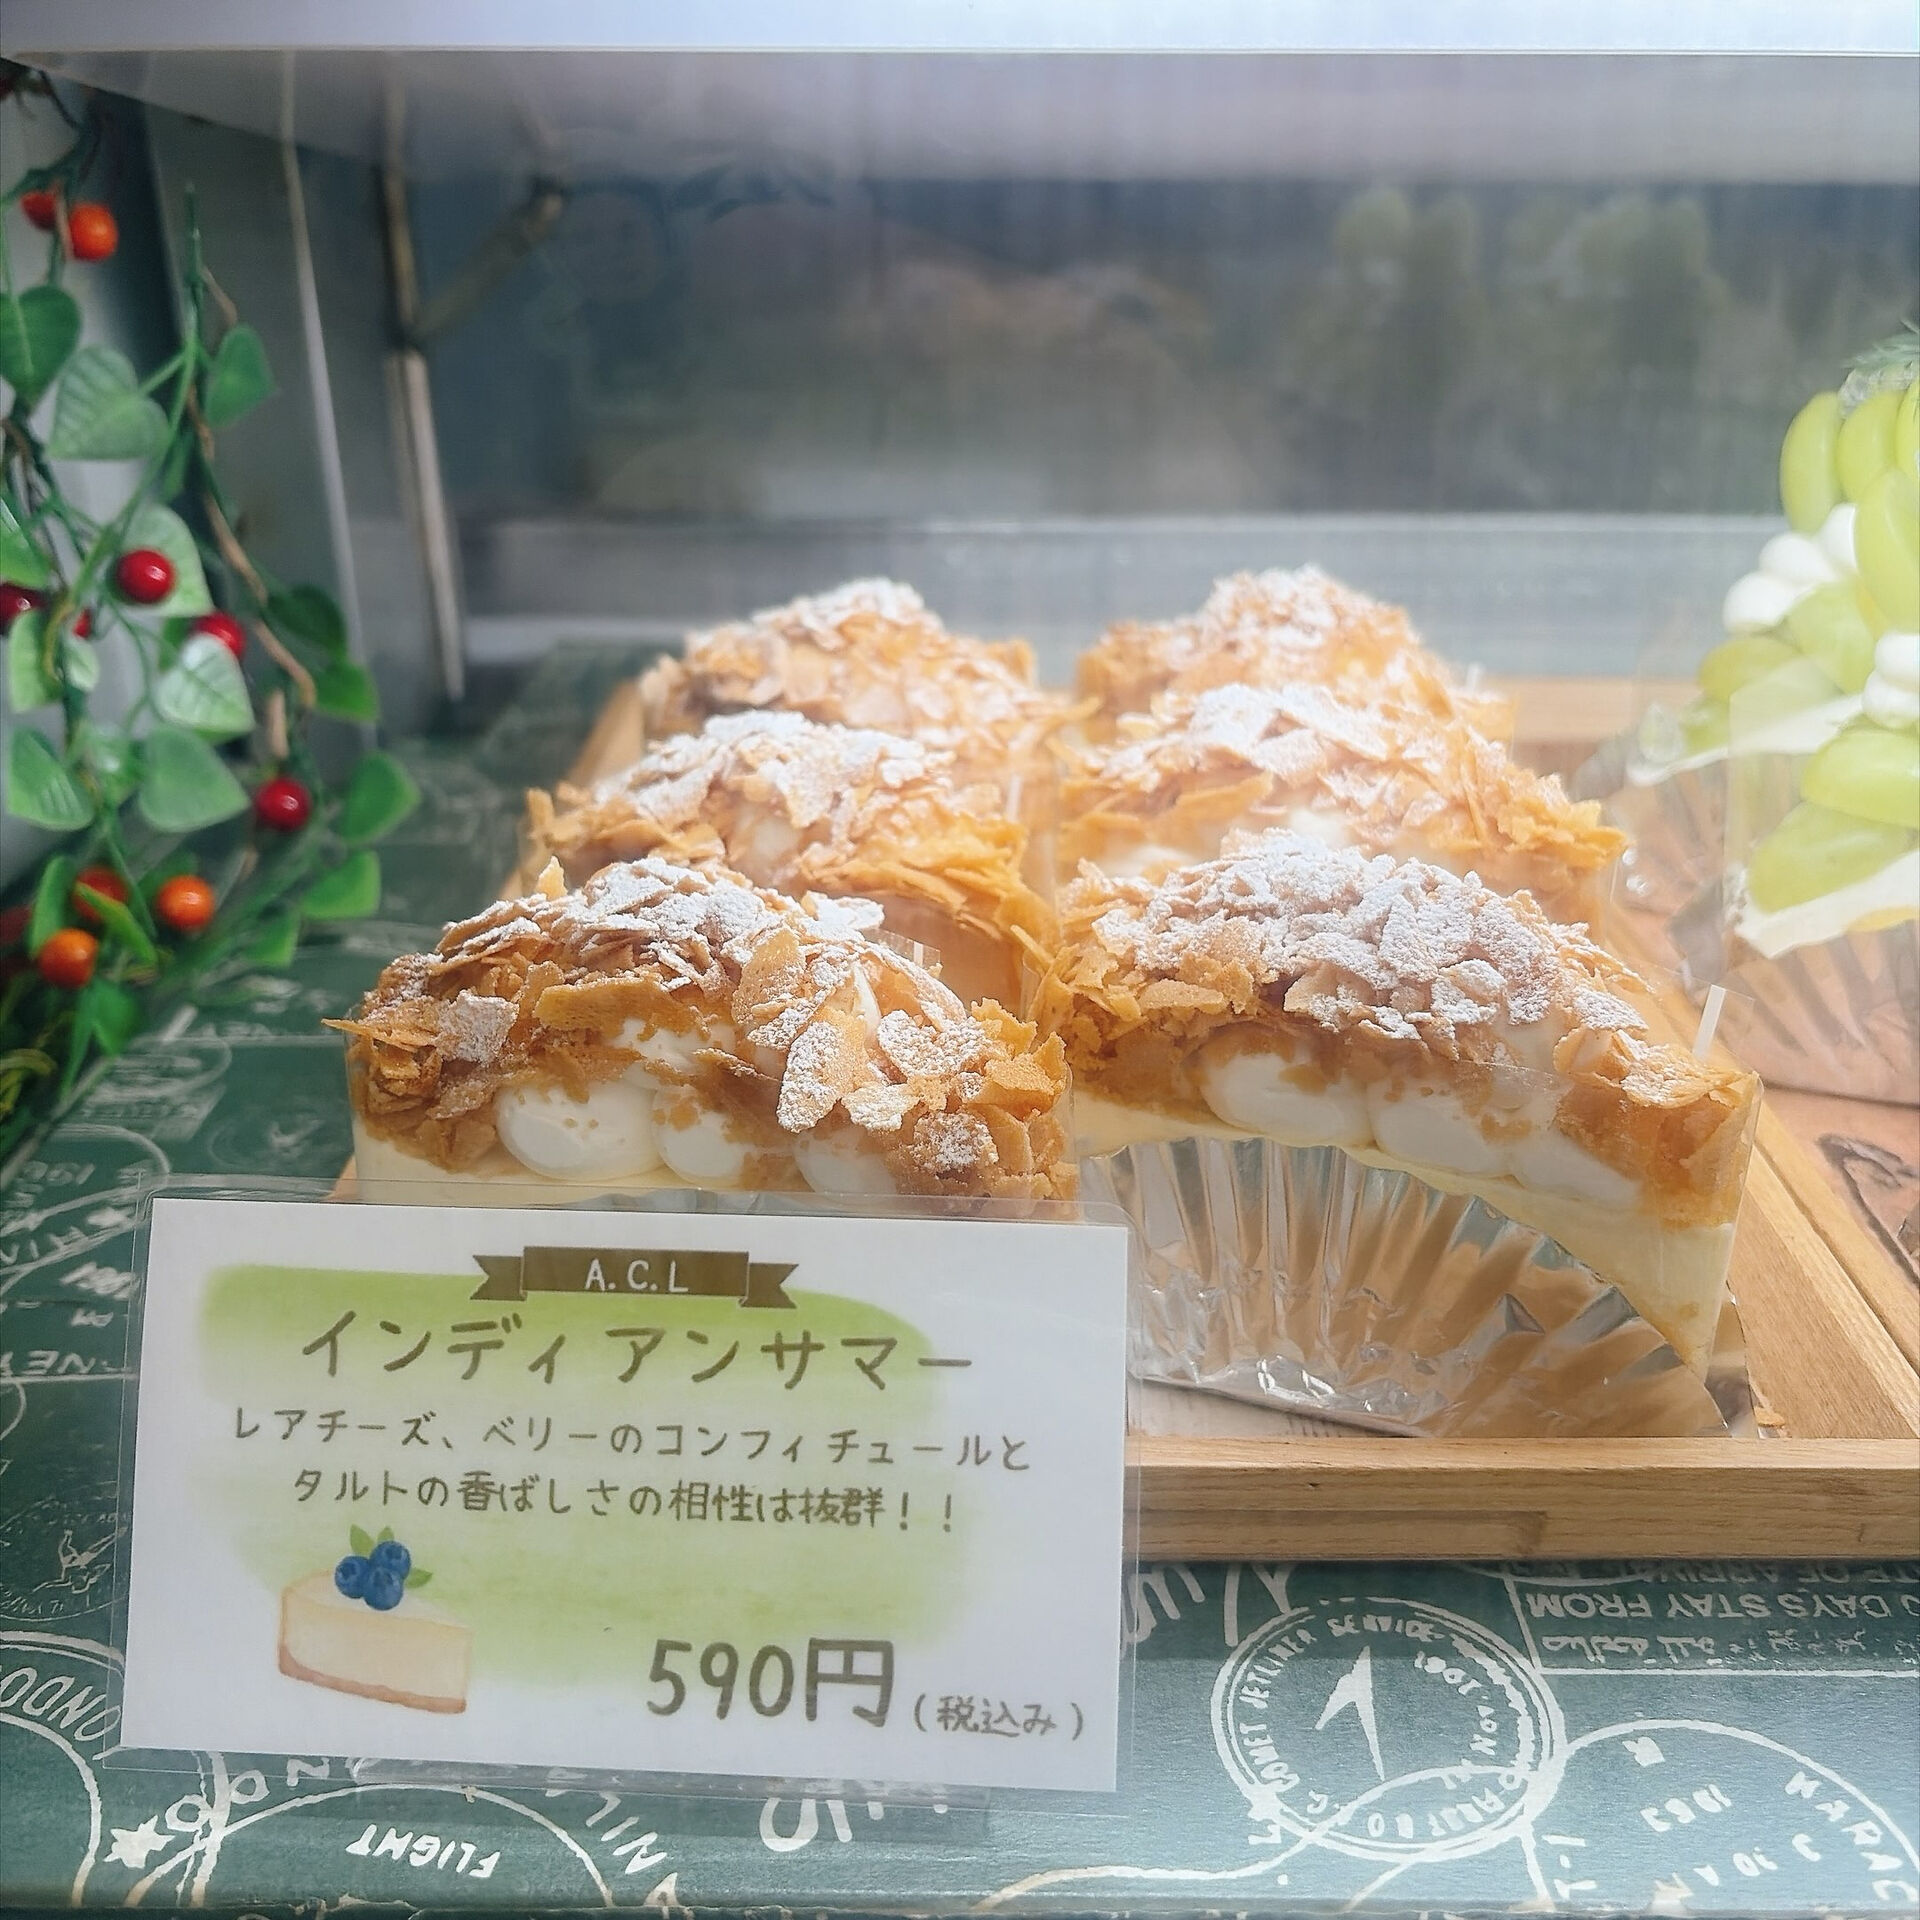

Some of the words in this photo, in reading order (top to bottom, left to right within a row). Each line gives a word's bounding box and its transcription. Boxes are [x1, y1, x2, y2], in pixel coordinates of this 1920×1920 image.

[584, 1259, 689, 1294] A.C.L
[302, 1310, 972, 1390] インディアンサマー
[235, 1406, 1031, 1471] レアチーズ、ベリーのコンフィチュールと
[294, 1469, 953, 1533] タルトの香ばしさの相性は抜群！！
[1526, 1593, 1652, 1619] FROM
[1666, 1593, 1772, 1619] STAY
[645, 1638, 895, 1728] 590円
[344, 1822, 502, 1879] FLIGHT
